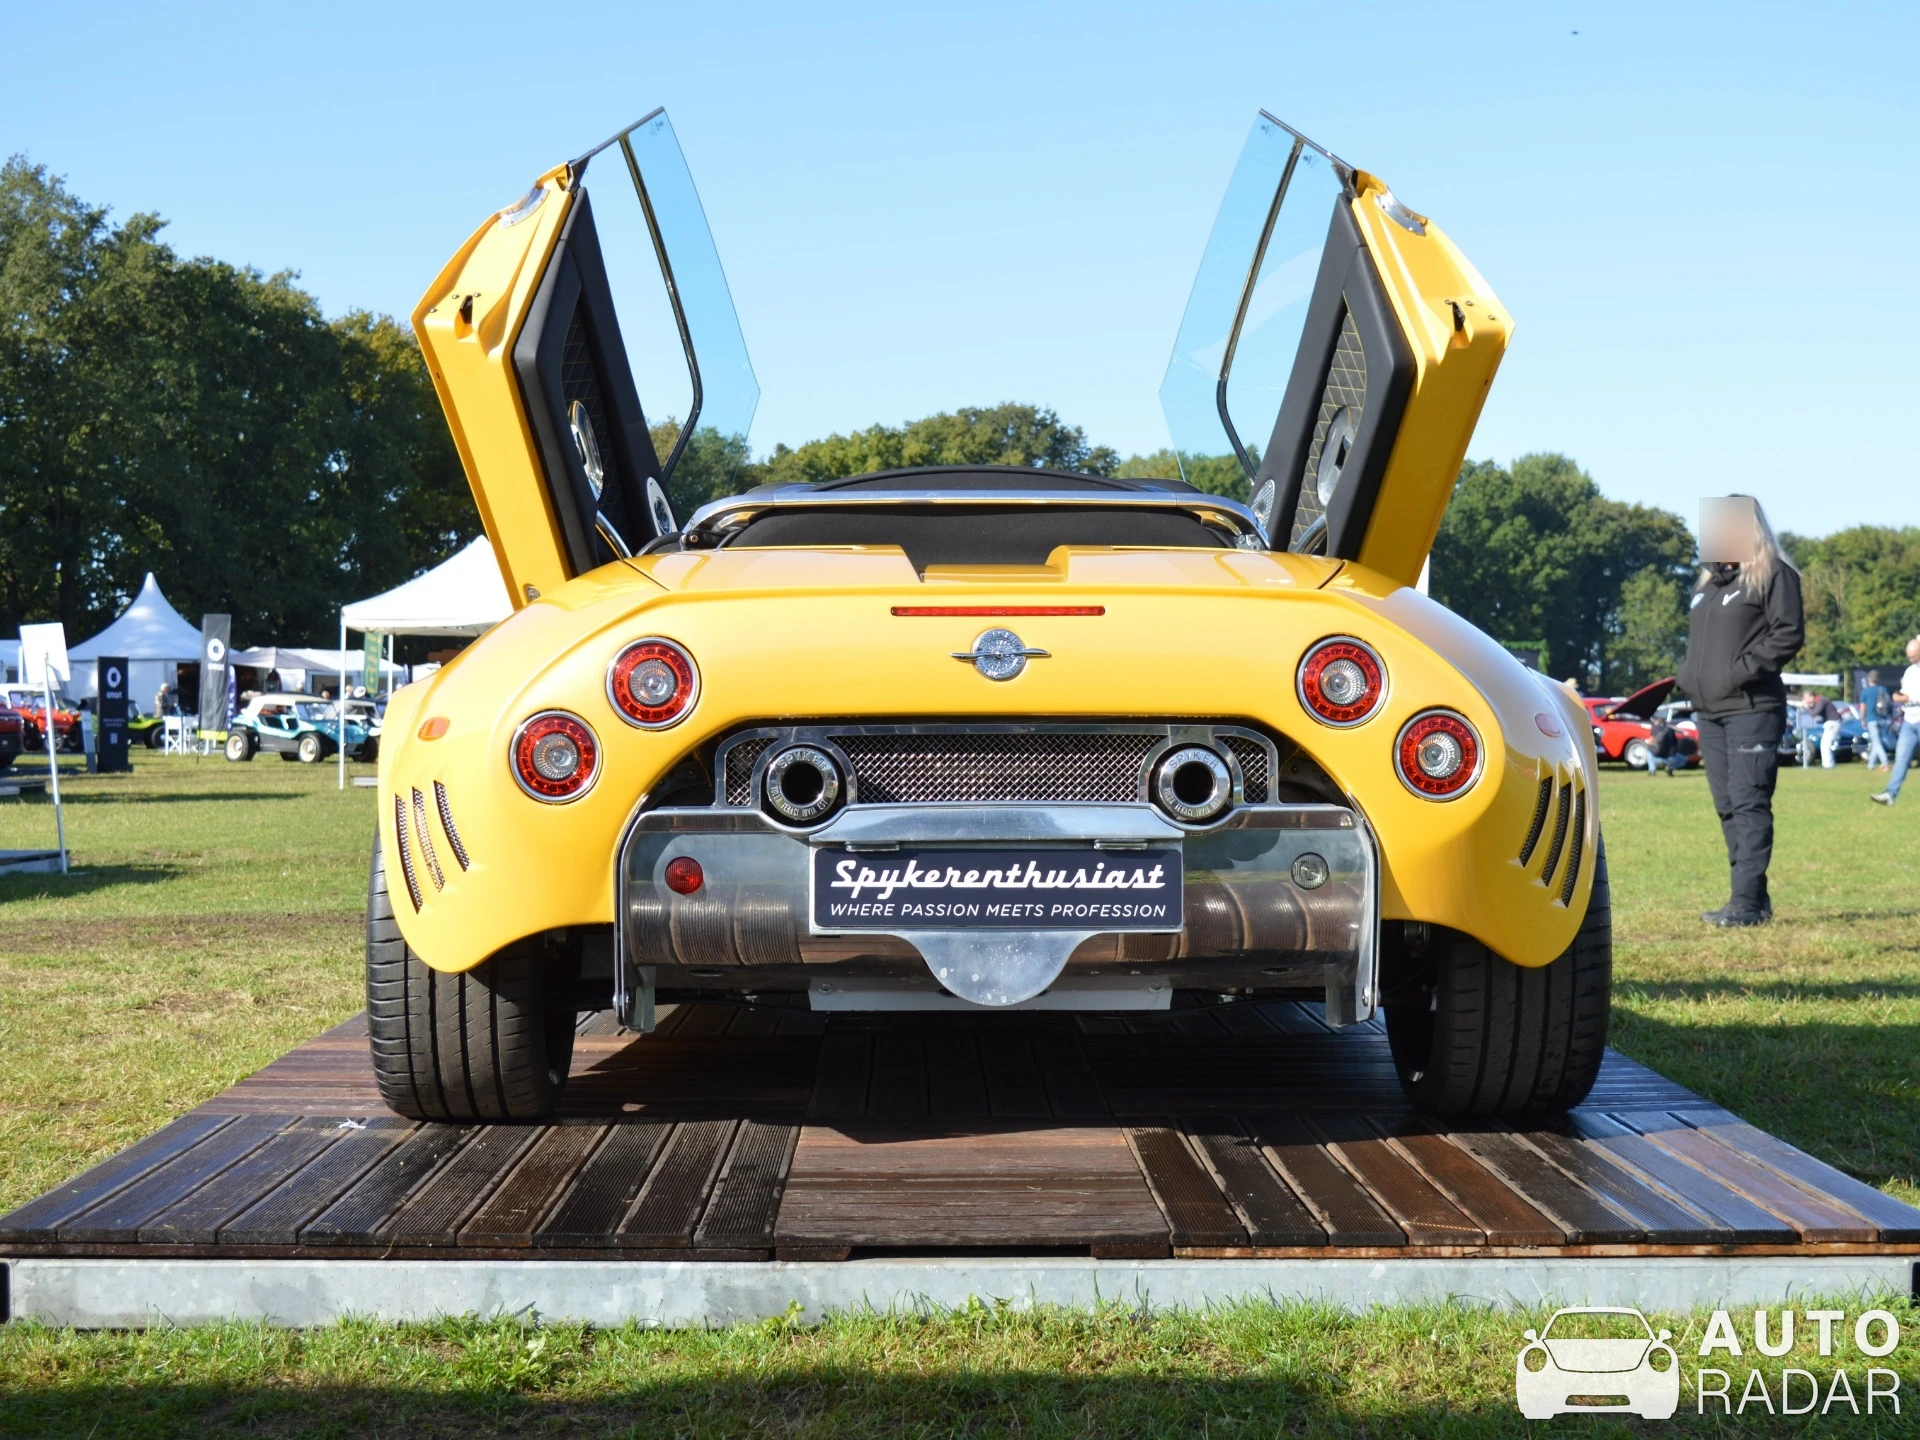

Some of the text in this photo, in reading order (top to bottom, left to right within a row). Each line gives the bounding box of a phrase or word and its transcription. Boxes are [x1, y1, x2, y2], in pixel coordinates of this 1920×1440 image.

[777, 750, 827, 771] SPYKER
[1168, 751, 1219, 770] SPYKER
[830, 859, 1166, 899] Spykerenthusiast
[830, 903, 1166, 917] WHERE PASSION MEETS PROFESSION
